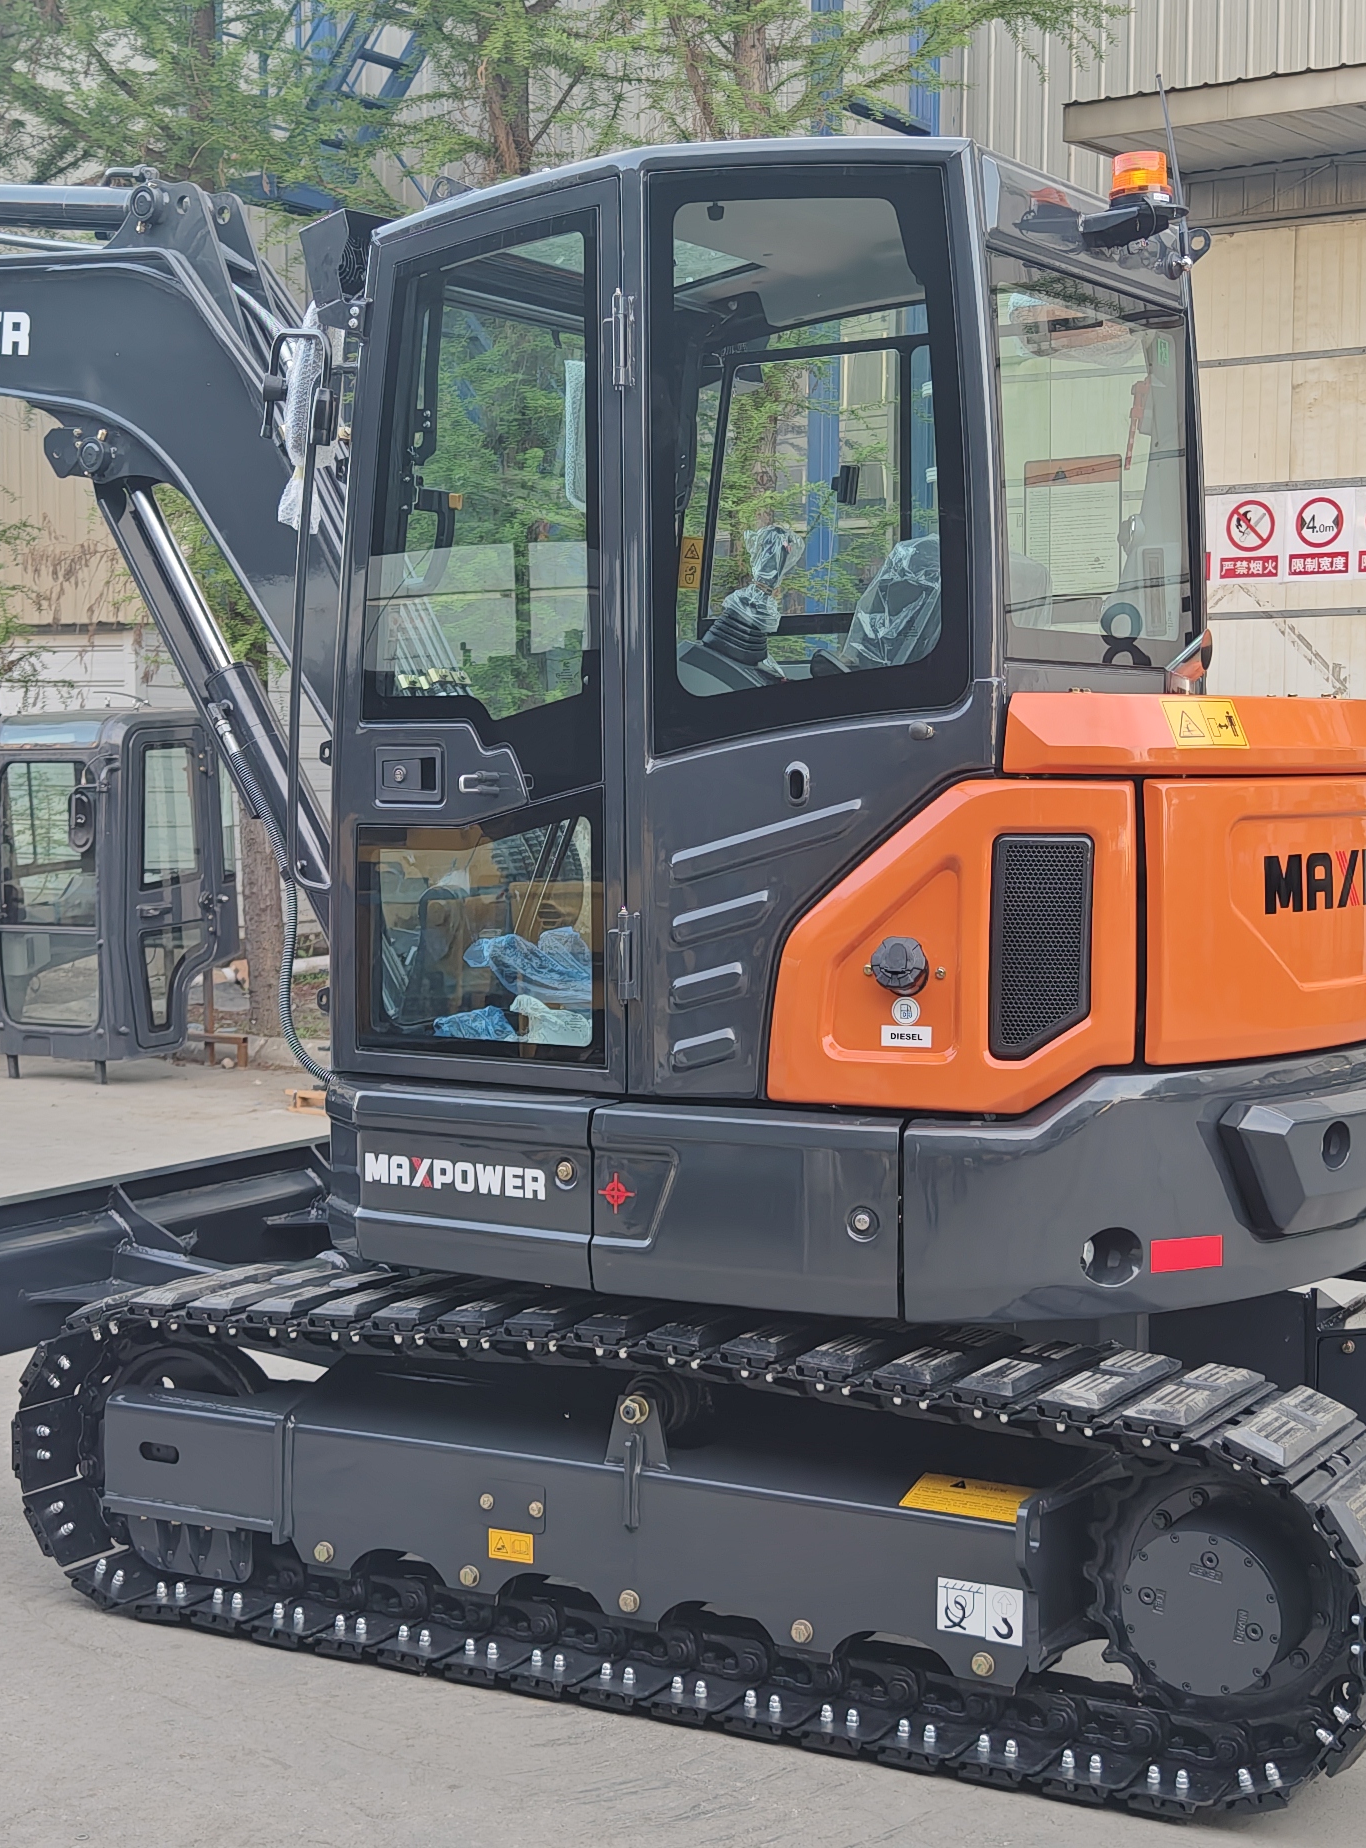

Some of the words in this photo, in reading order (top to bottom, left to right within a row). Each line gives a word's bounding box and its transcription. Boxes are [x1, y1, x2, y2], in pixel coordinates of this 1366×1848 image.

[1306, 513, 1335, 534] 4.0m
[1220, 559, 1277, 576] 严禁烟火
[1291, 555, 1347, 573] 限制宽度
[890, 1032, 923, 1041] DIESEL
[364, 1152, 546, 1200] MAXPOWER
